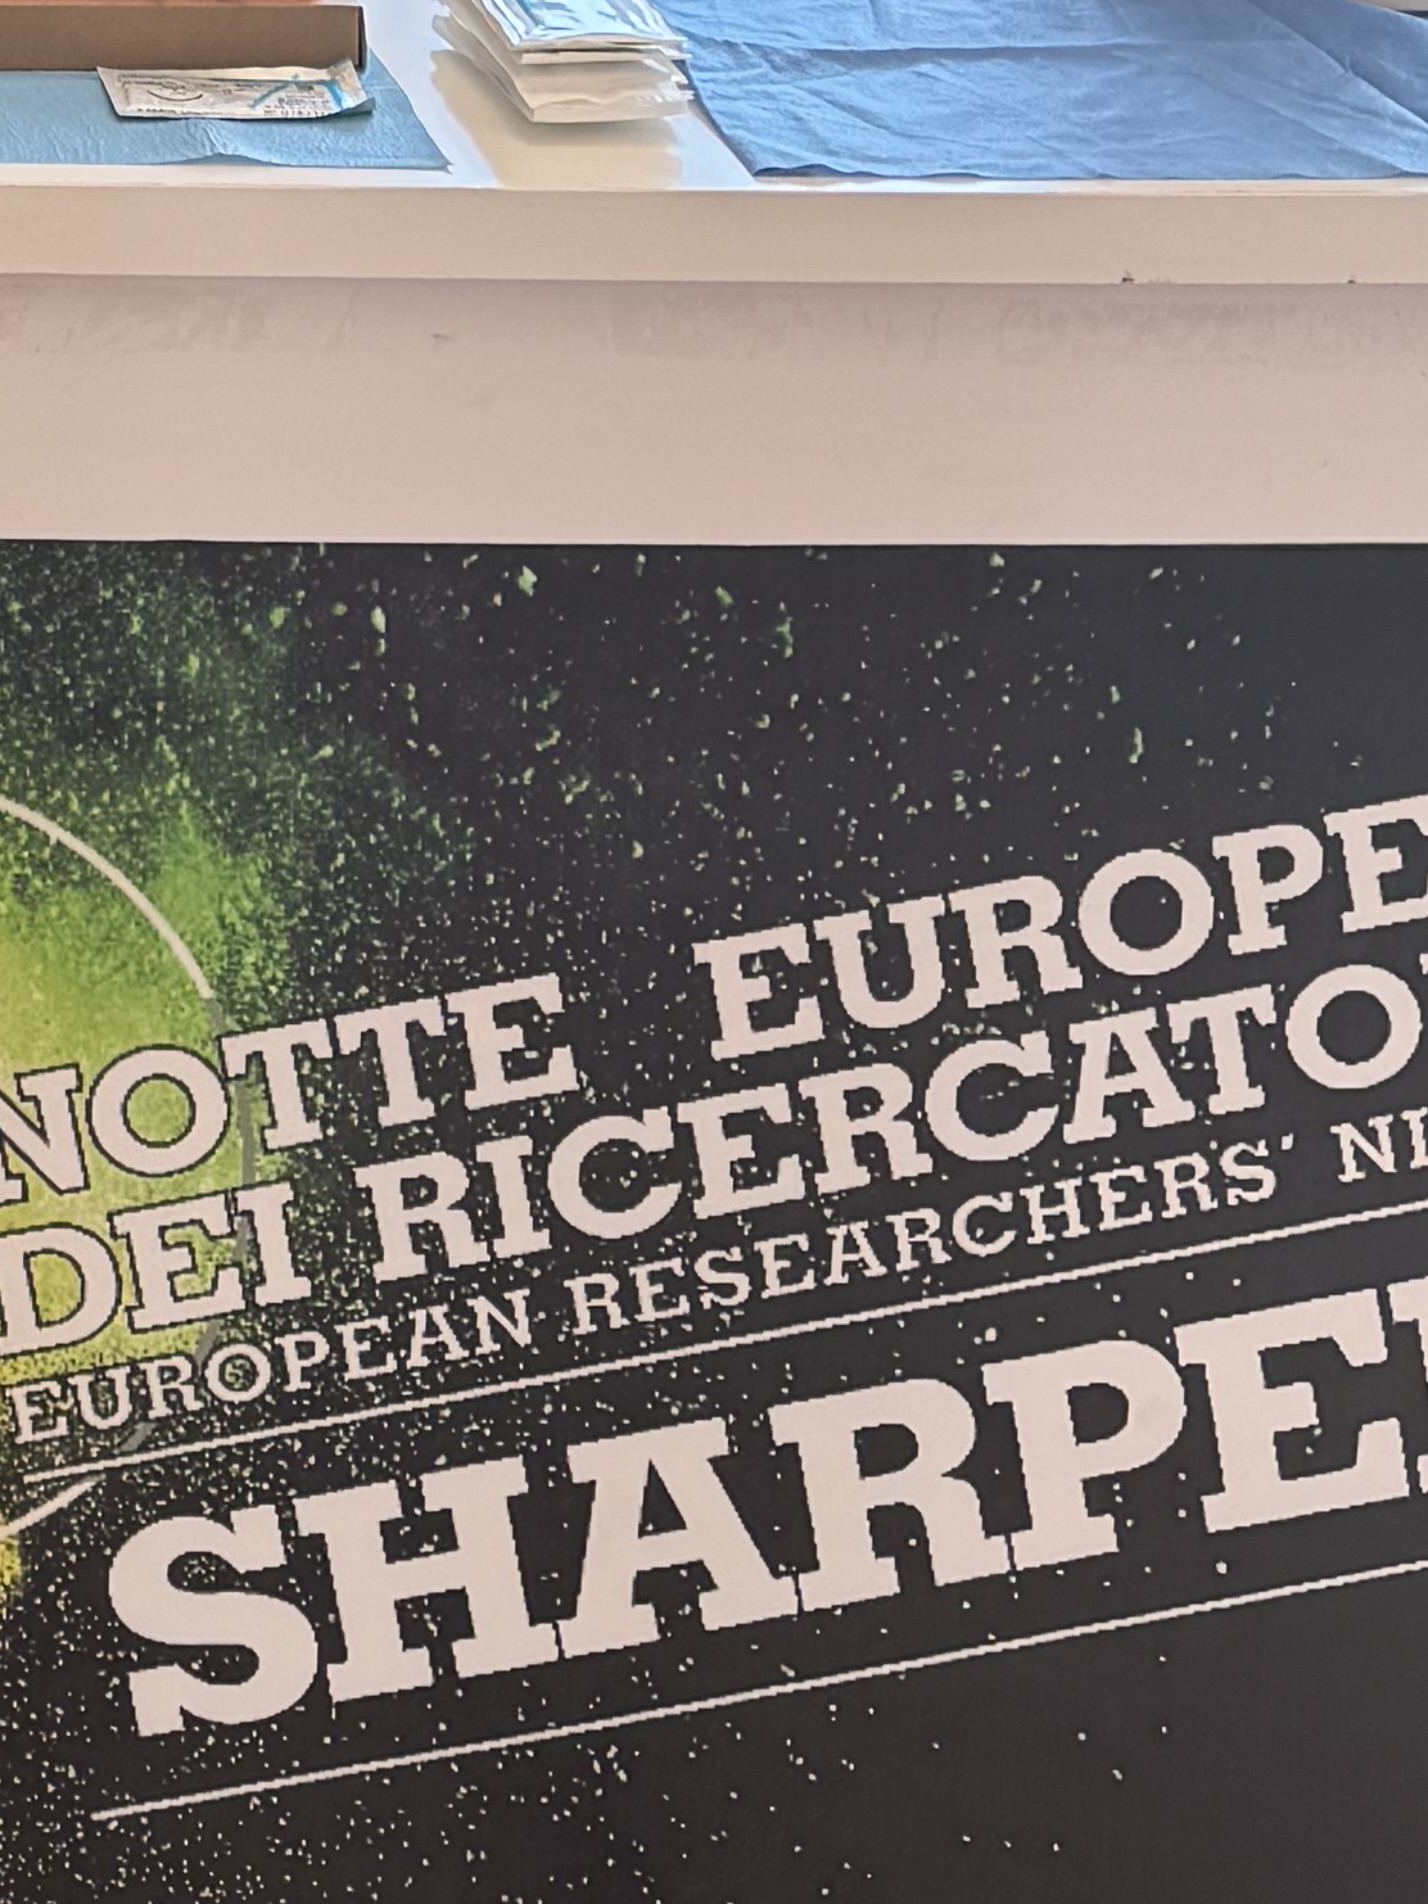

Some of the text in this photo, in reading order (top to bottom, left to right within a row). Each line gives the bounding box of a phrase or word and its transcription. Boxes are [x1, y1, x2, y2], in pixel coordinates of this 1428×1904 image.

[8, 1106, 1428, 1447] EUROPEAN RESEARCHERS' NI
[354, 951, 1428, 1284] RICERCATO
[105, 1275, 1428, 1739] SHARPE
